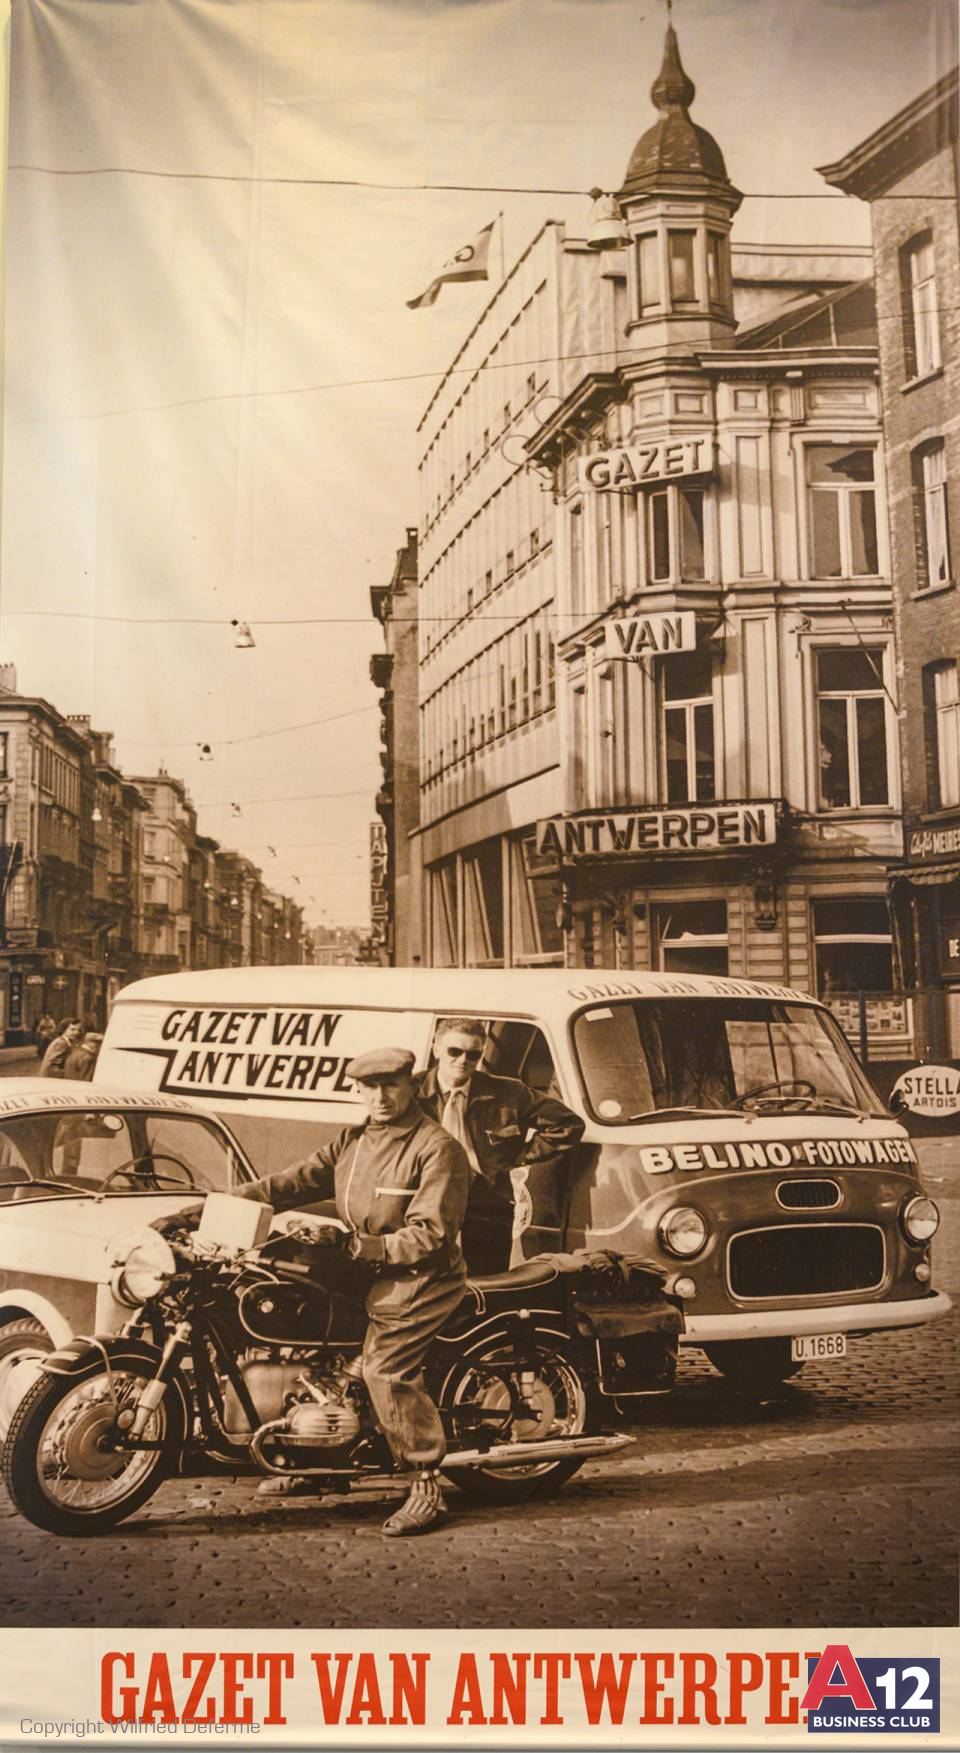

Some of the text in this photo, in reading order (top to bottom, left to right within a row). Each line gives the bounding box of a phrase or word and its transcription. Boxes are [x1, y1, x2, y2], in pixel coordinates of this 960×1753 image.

[585, 439, 705, 489] GAZET
[614, 616, 682, 655] VAN
[539, 808, 767, 856] ANTWERPEN
[567, 981, 643, 1001] GAZET
[655, 979, 700, 994] VAN
[161, 1009, 343, 1047] GAZET VAN
[177, 1050, 359, 1093] ANTWERPE
[913, 1096, 957, 1108] ARTOIS
[640, 1142, 792, 1174] BELINO
[795, 1336, 844, 1358] U.1668
[101, 1651, 822, 1725] GAZET VAN ANTWERPE
